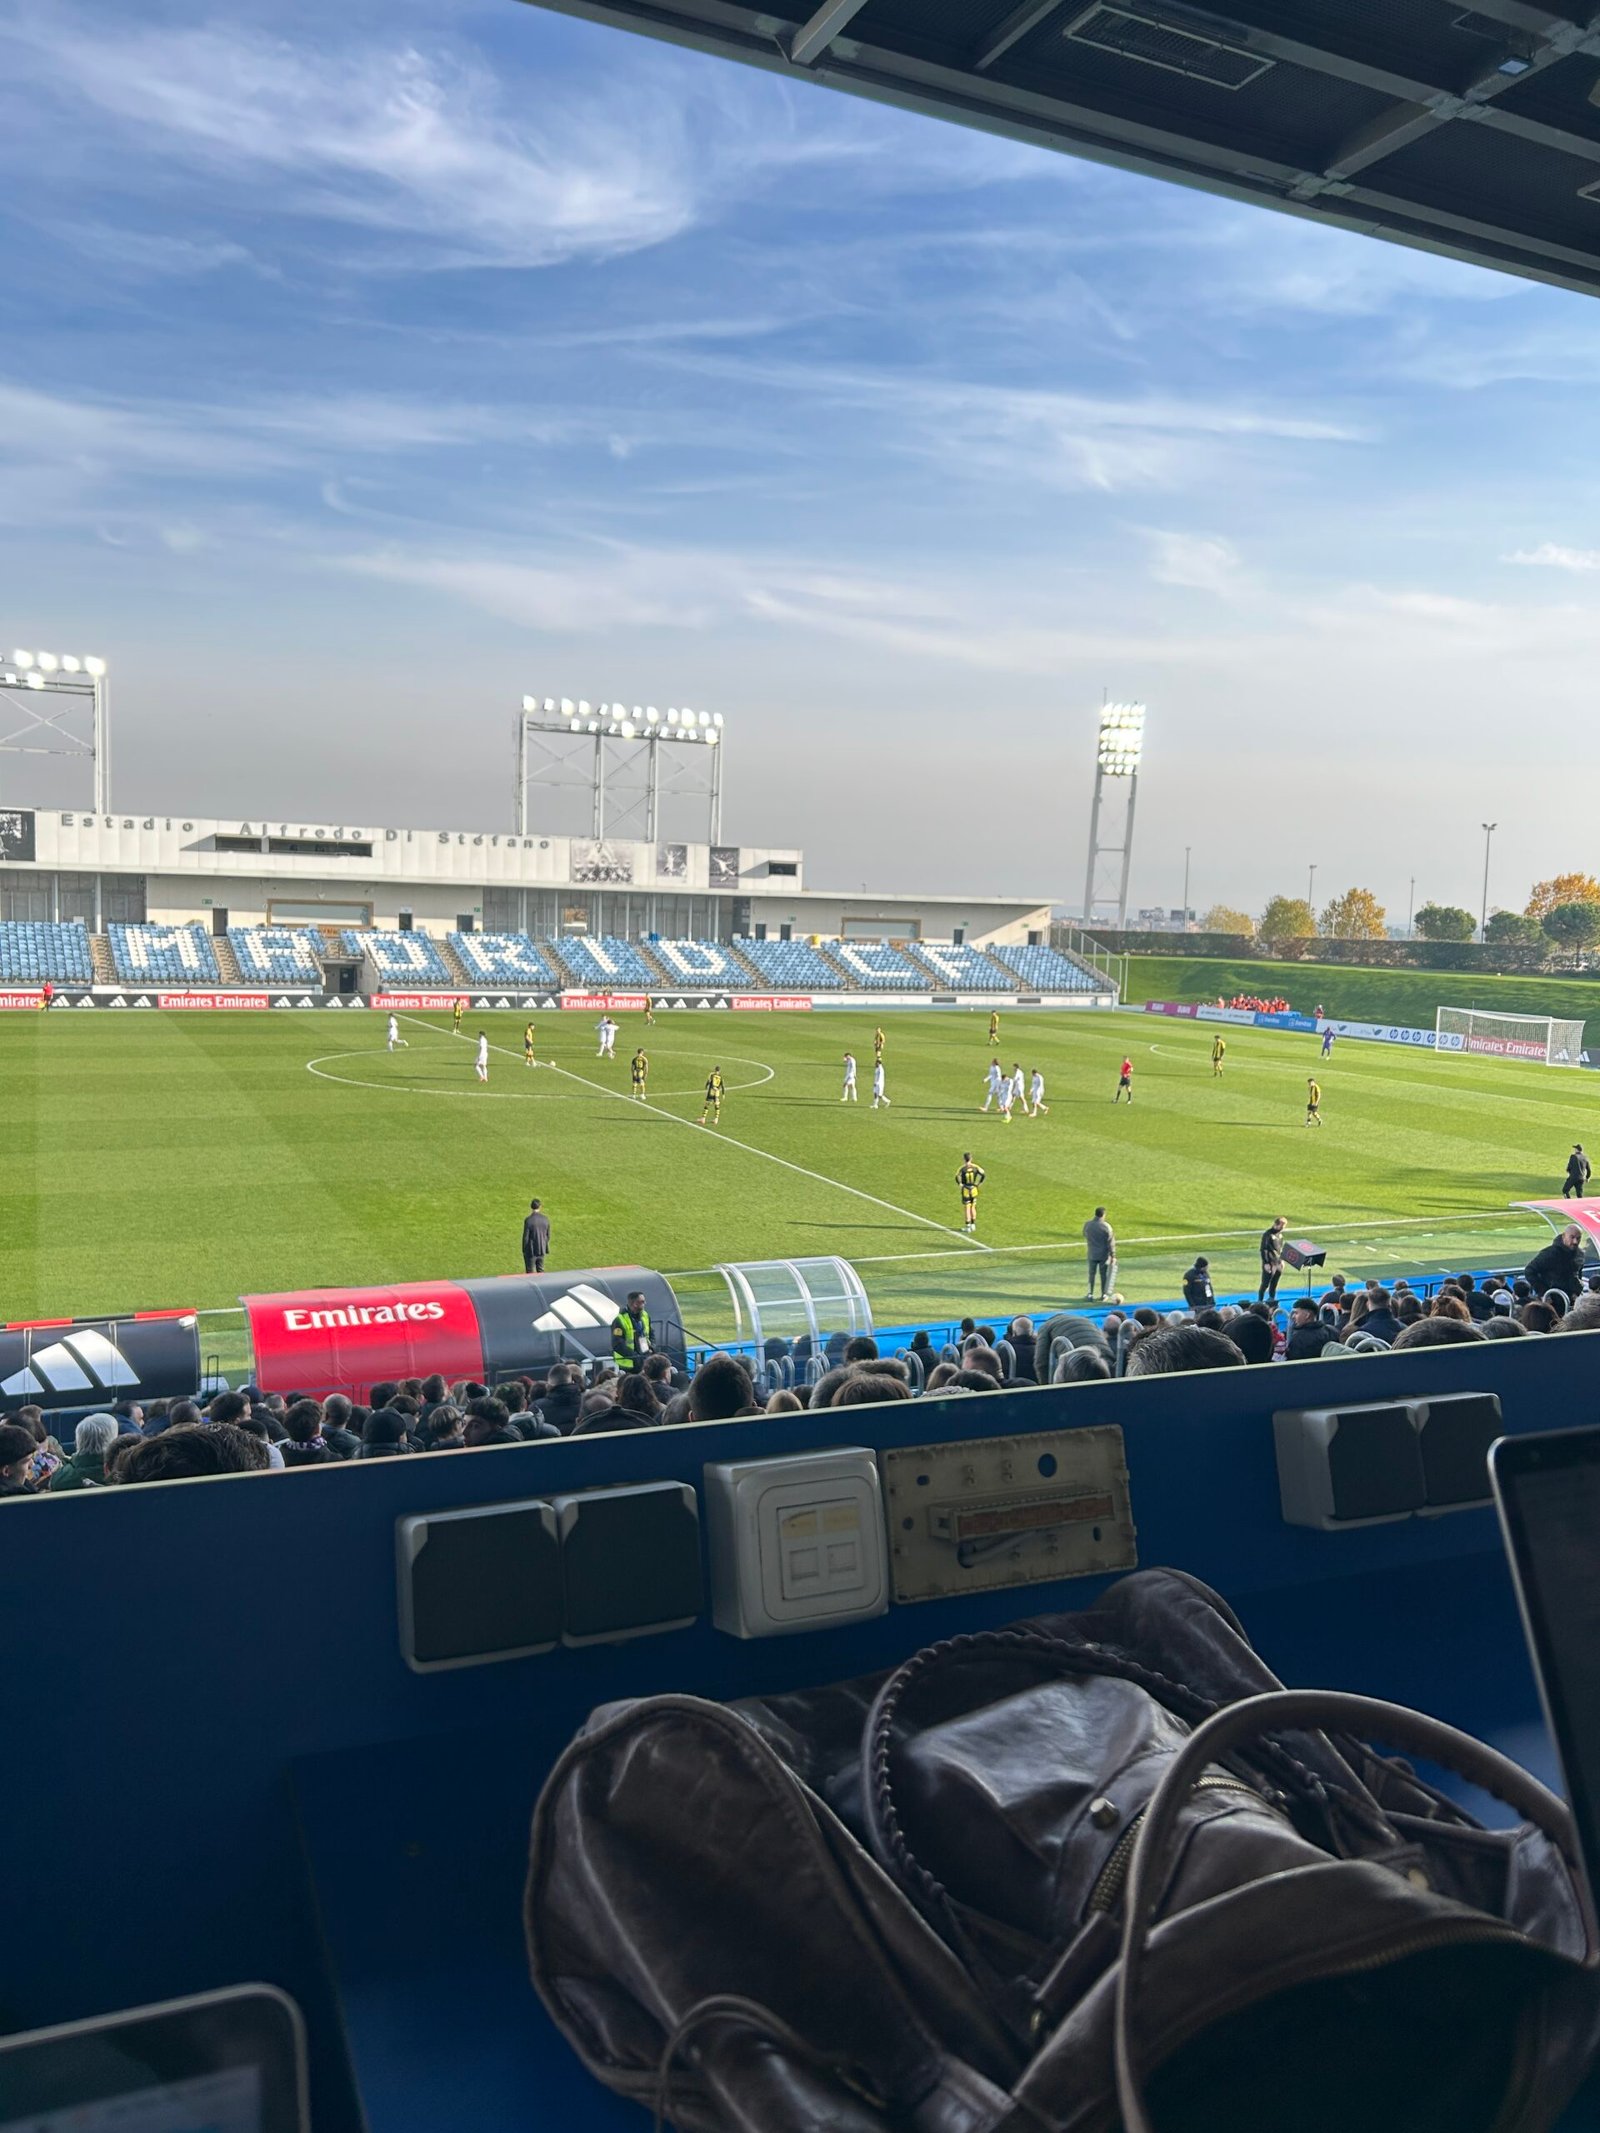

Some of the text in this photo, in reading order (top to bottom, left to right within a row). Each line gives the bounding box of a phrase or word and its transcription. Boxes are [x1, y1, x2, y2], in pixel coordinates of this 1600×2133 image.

[61, 814, 193, 832] Estadio
[239, 822, 362, 840] Alfredo
[386, 829, 412, 843] Di
[160, 995, 267, 1008] Emirates Emirates
[373, 996, 420, 1008] Emirates
[563, 997, 646, 1009] Emirates Emirate
[733, 998, 812, 1009] Emirates Emirates
[1506, 1042, 1548, 1057] Emirates
[283, 1301, 445, 1331] Emirates
